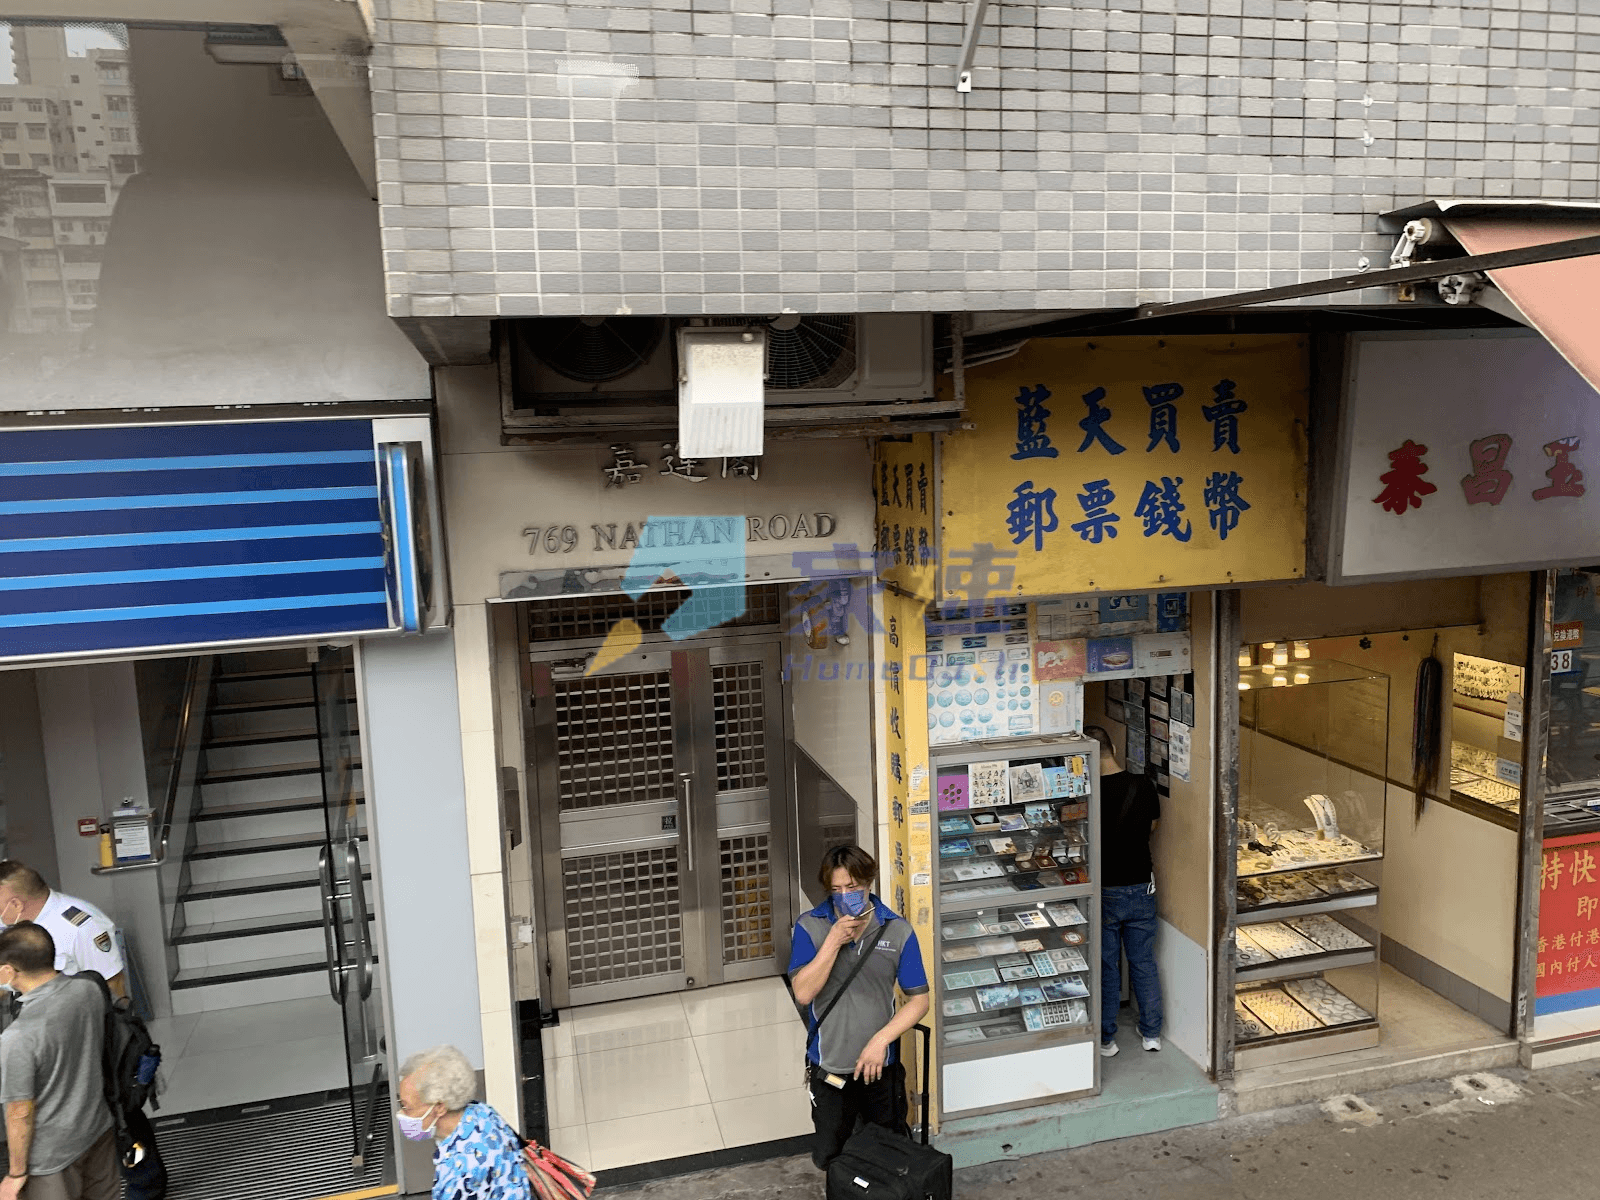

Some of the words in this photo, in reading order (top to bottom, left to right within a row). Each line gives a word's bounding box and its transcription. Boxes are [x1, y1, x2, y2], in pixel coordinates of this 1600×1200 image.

[1009, 378, 1248, 461] 藍天買賣
[880, 460, 929, 516] 藍天買賣
[1005, 470, 1252, 552] 郵票錢幣
[522, 525, 578, 555] 769
[591, 515, 736, 552] NATHAN
[746, 512, 837, 543] ROAD
[1576, 895, 1599, 921] 即
